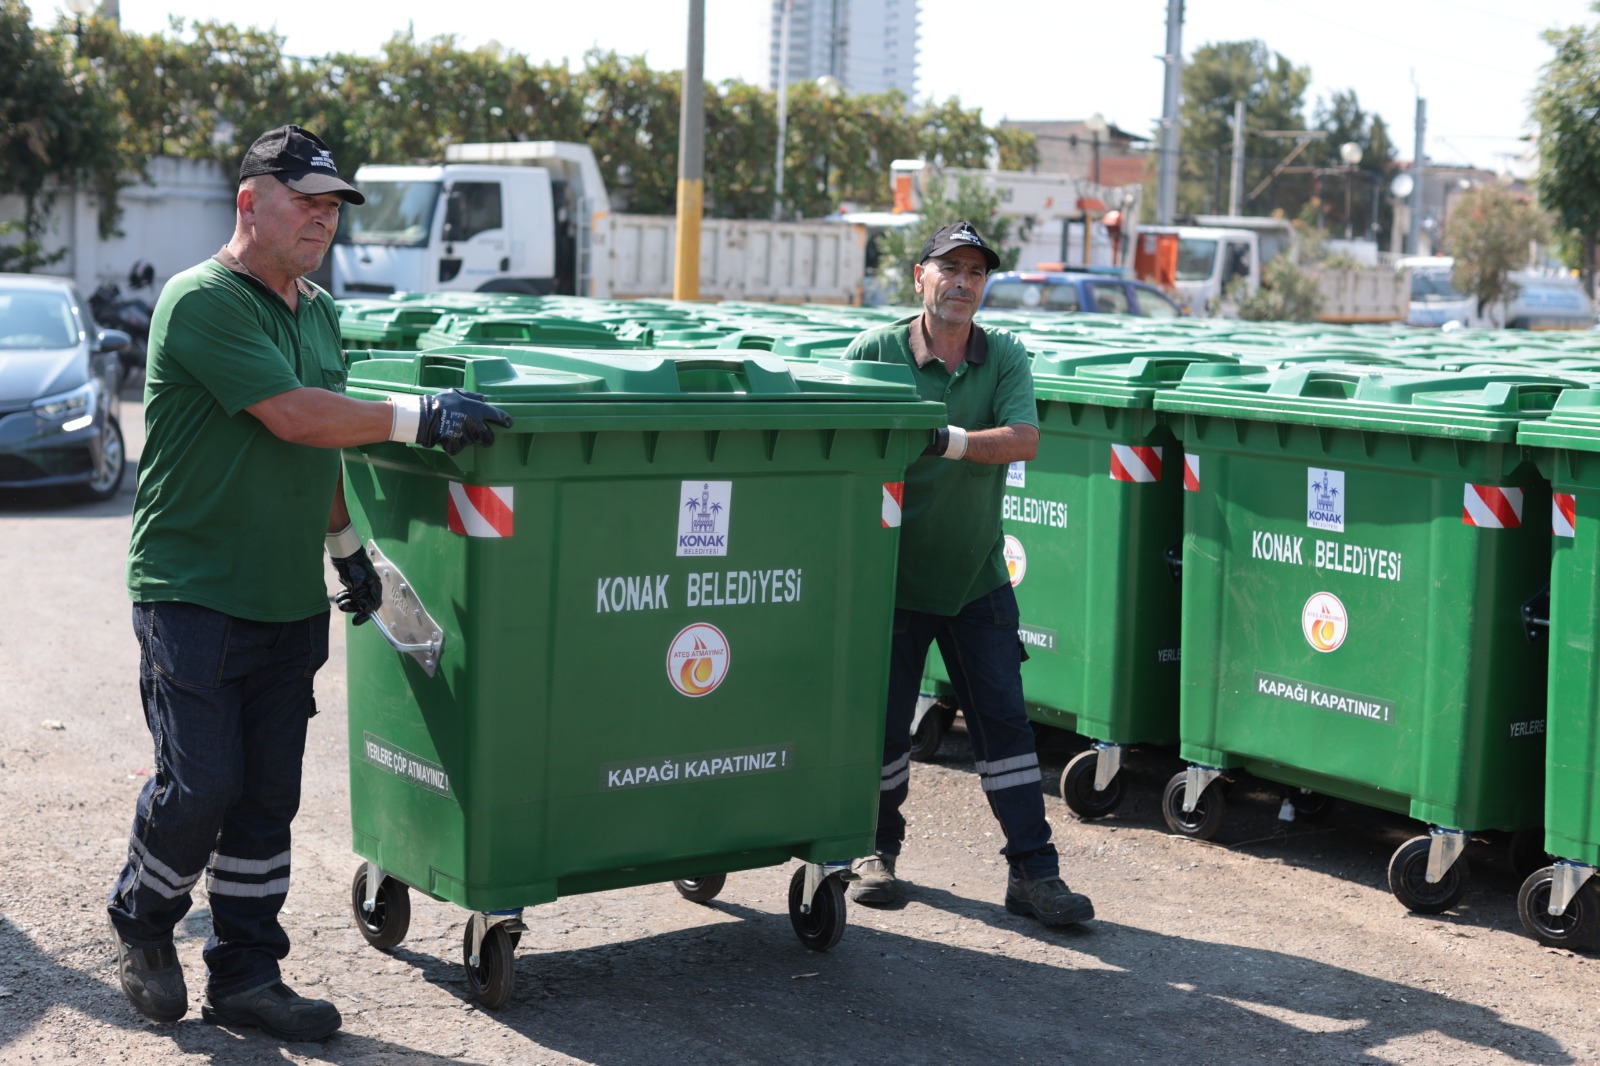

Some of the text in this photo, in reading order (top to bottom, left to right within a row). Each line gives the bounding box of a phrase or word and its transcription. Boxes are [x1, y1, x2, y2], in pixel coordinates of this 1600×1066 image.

[1309, 510, 1341, 524] KONAK
[680, 535, 725, 547] KONAK
[1252, 530, 1303, 565] KONAK
[596, 574, 669, 613] KONAK
[691, 648, 724, 657] ATMAYINIZ
[1049, 636, 1053, 648] !
[1259, 678, 1388, 721] KAPAĞI KAPATINIZ !
[1510, 719, 1545, 737] YERLERE
[365, 740, 393, 768] YERLERE
[408, 760, 445, 790] ATMAYINIZ
[608, 750, 786, 787] KAPAĞI KAPATINIZ !
